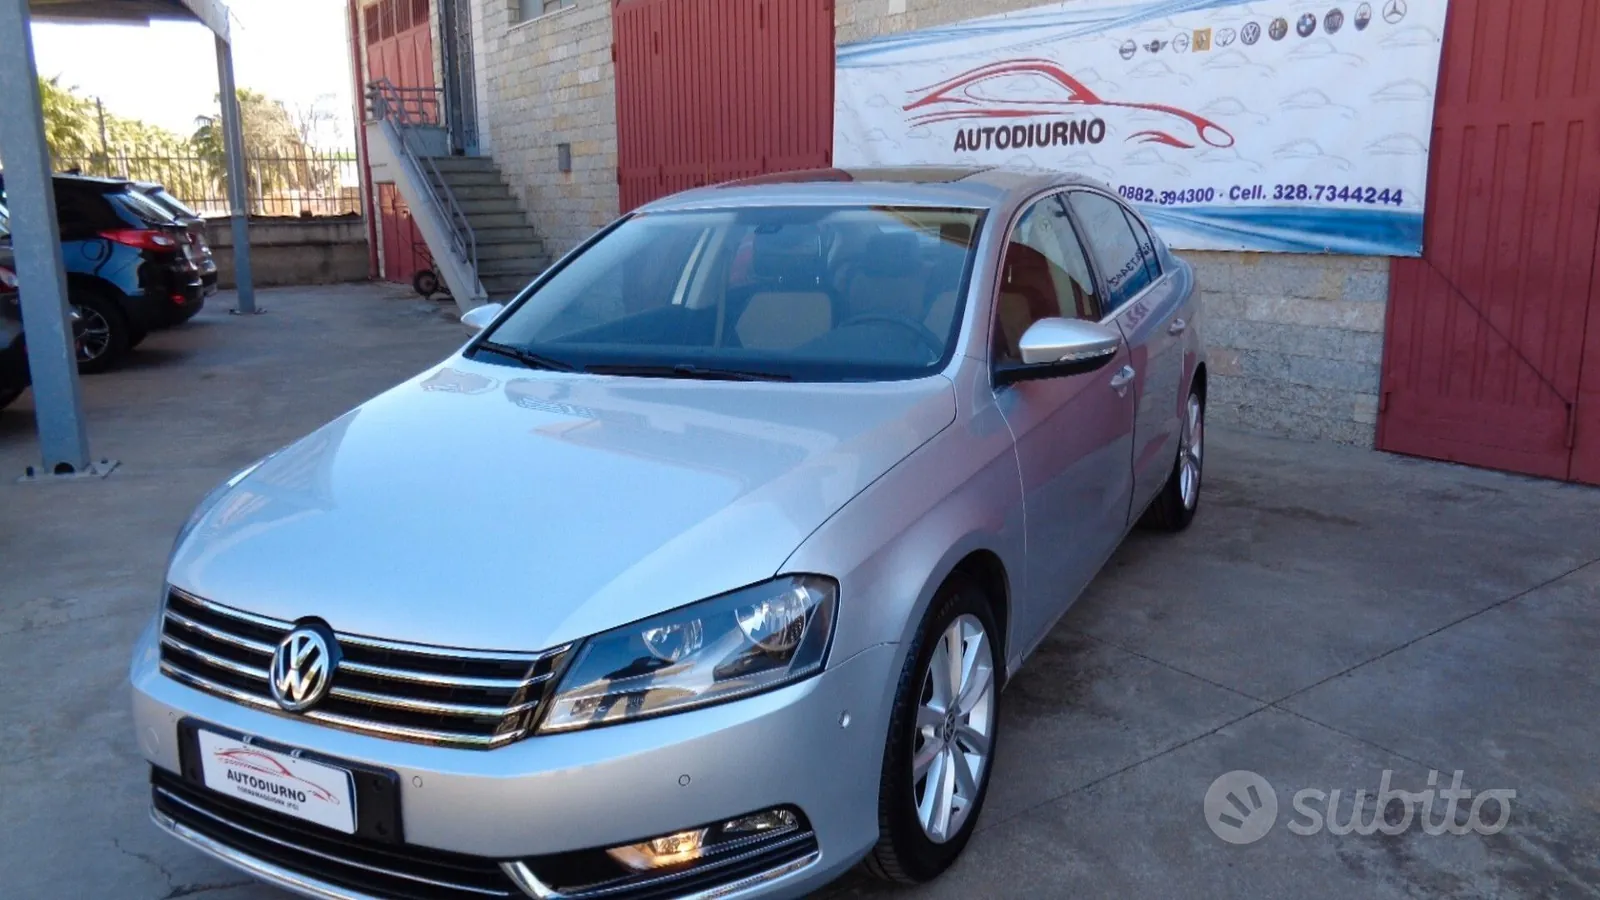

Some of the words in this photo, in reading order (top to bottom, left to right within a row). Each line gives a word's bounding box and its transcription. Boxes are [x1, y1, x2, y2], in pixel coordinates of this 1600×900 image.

[953, 118, 1106, 153] AUTODIURNO
[1118, 185, 1215, 206] 0882.394300
[1229, 184, 1267, 201] Cell.
[1273, 184, 1404, 206] 328.7344244
[226, 768, 307, 803] AUTODIURNO
